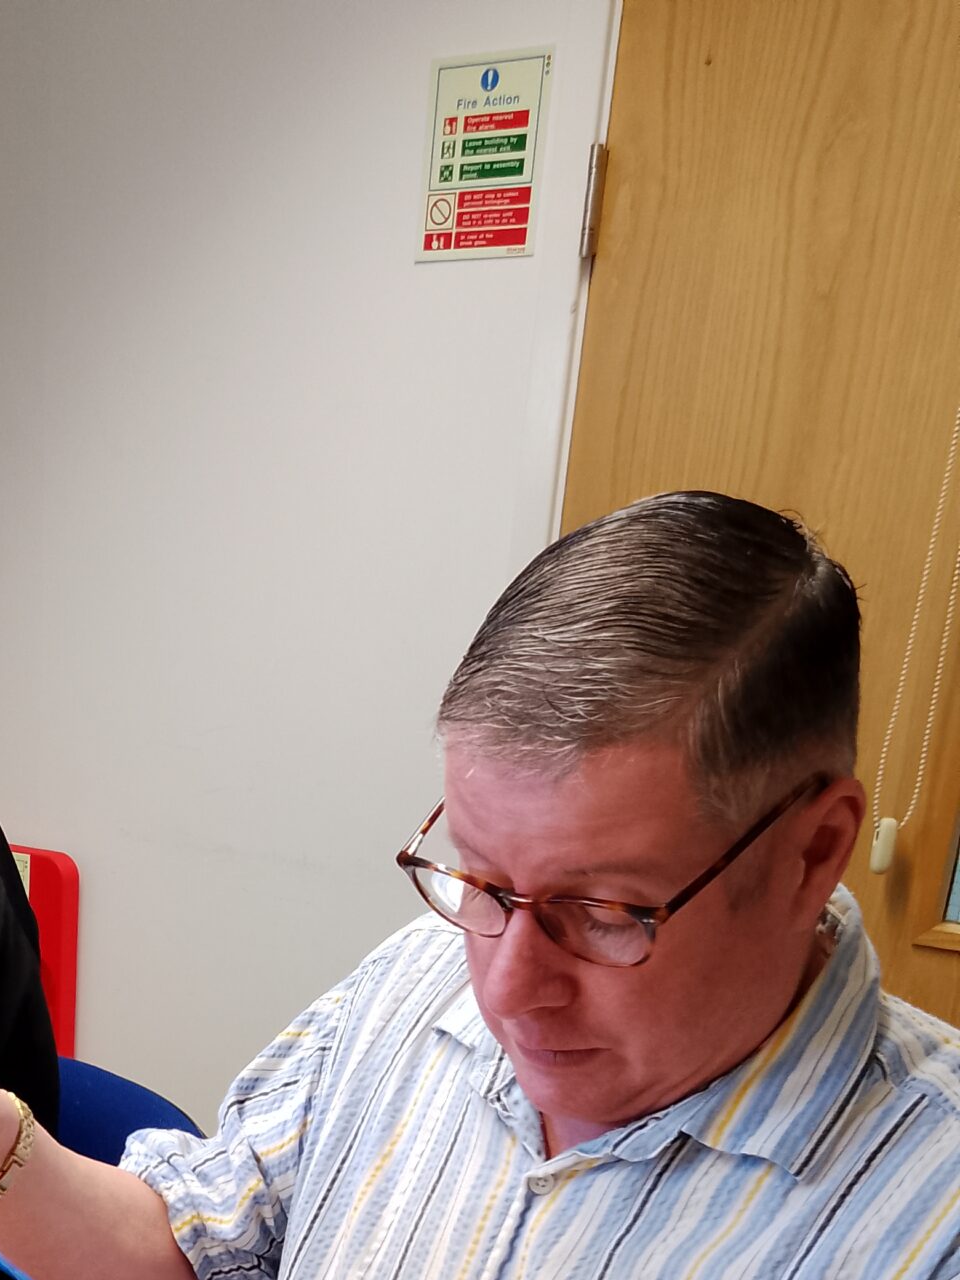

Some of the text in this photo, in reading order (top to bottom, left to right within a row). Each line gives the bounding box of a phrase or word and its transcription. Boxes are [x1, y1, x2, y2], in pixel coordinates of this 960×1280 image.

[457, 94, 520, 110] Fire Action
[467, 112, 514, 124] Operate nearest
[466, 124, 477, 132] fire
[465, 136, 518, 148] Leave building by
[475, 146, 498, 154] nearest
[462, 163, 482, 172] Report
[492, 161, 520, 169] assembly
